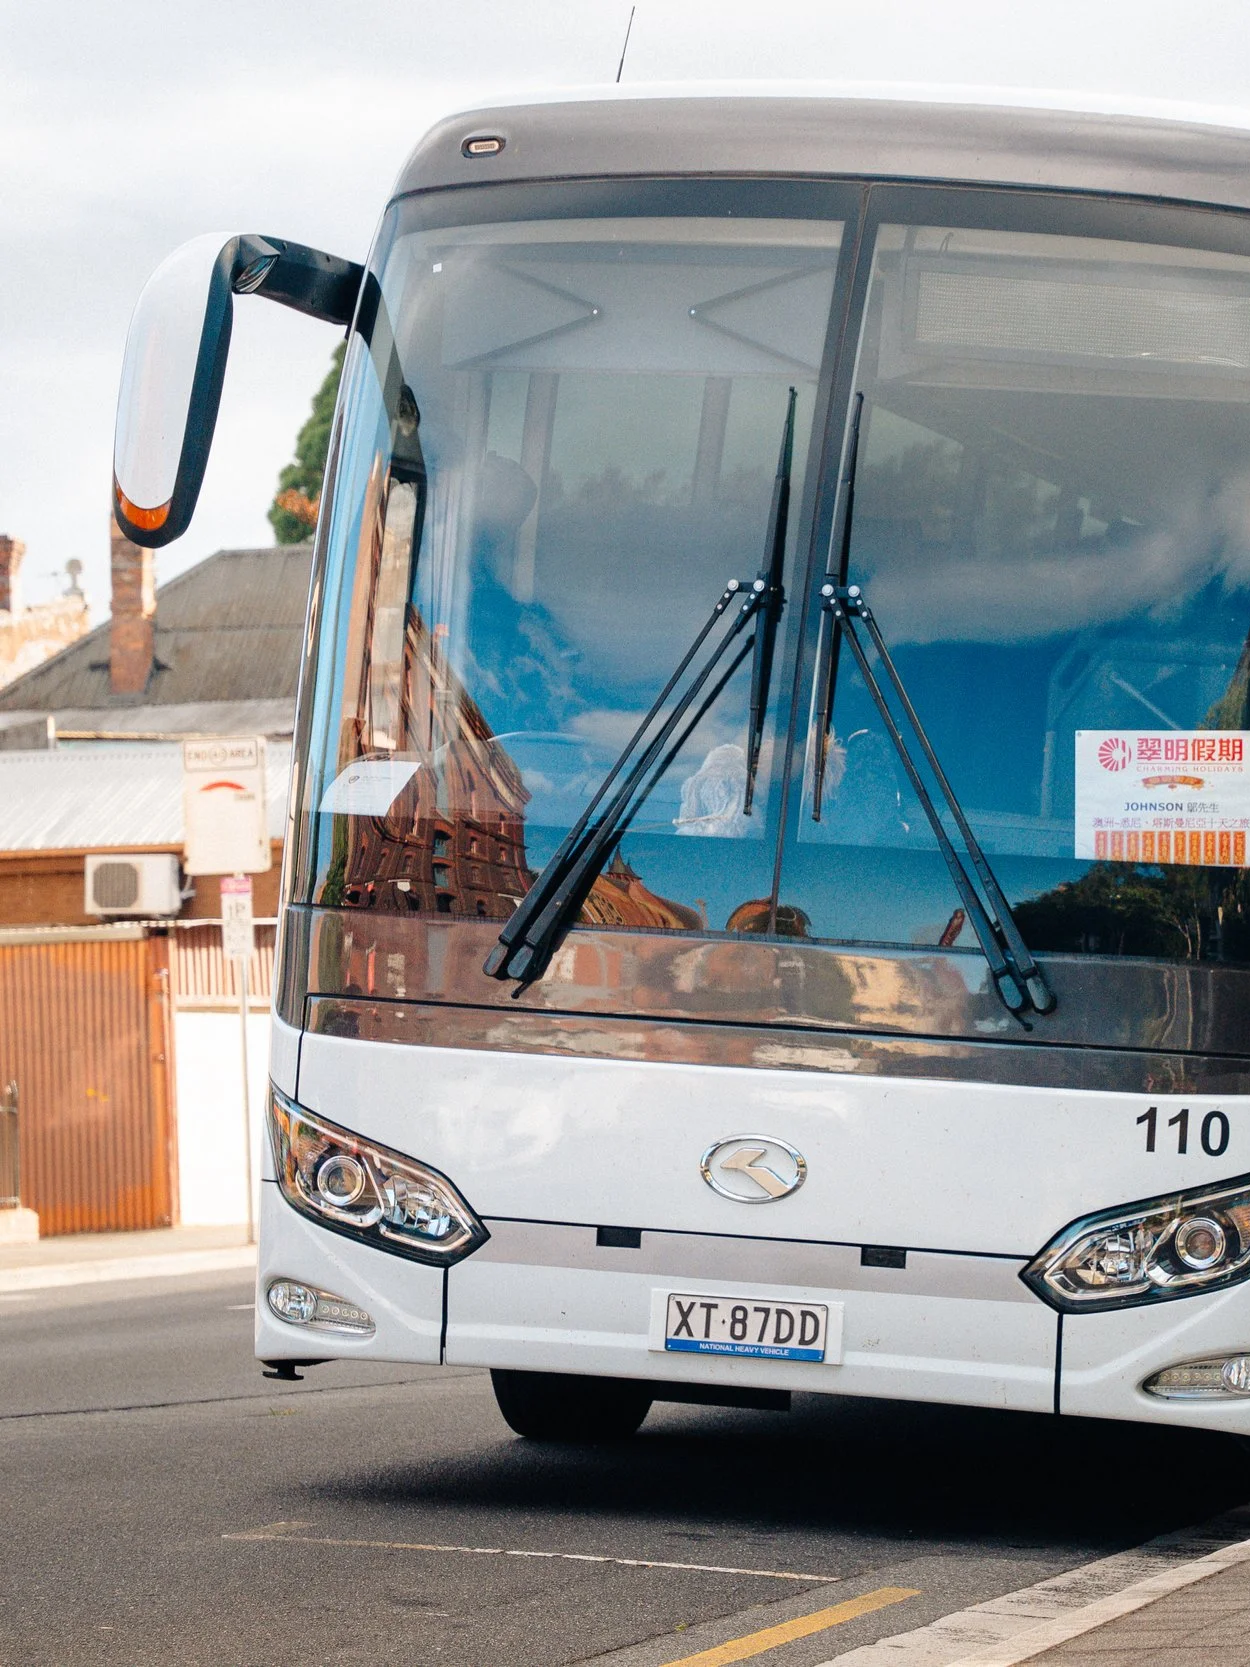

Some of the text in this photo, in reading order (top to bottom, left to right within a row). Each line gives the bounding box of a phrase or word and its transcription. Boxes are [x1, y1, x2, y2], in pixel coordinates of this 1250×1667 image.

[1137, 738, 1243, 761] 翠明假期
[1136, 765, 1244, 773] CHARMING HOLIDAYS
[1124, 802, 1183, 812] JOHNSON
[1136, 1107, 1230, 1157] 110
[699, 1342, 789, 1357] NATIONAL HEAVY VEHICLE
